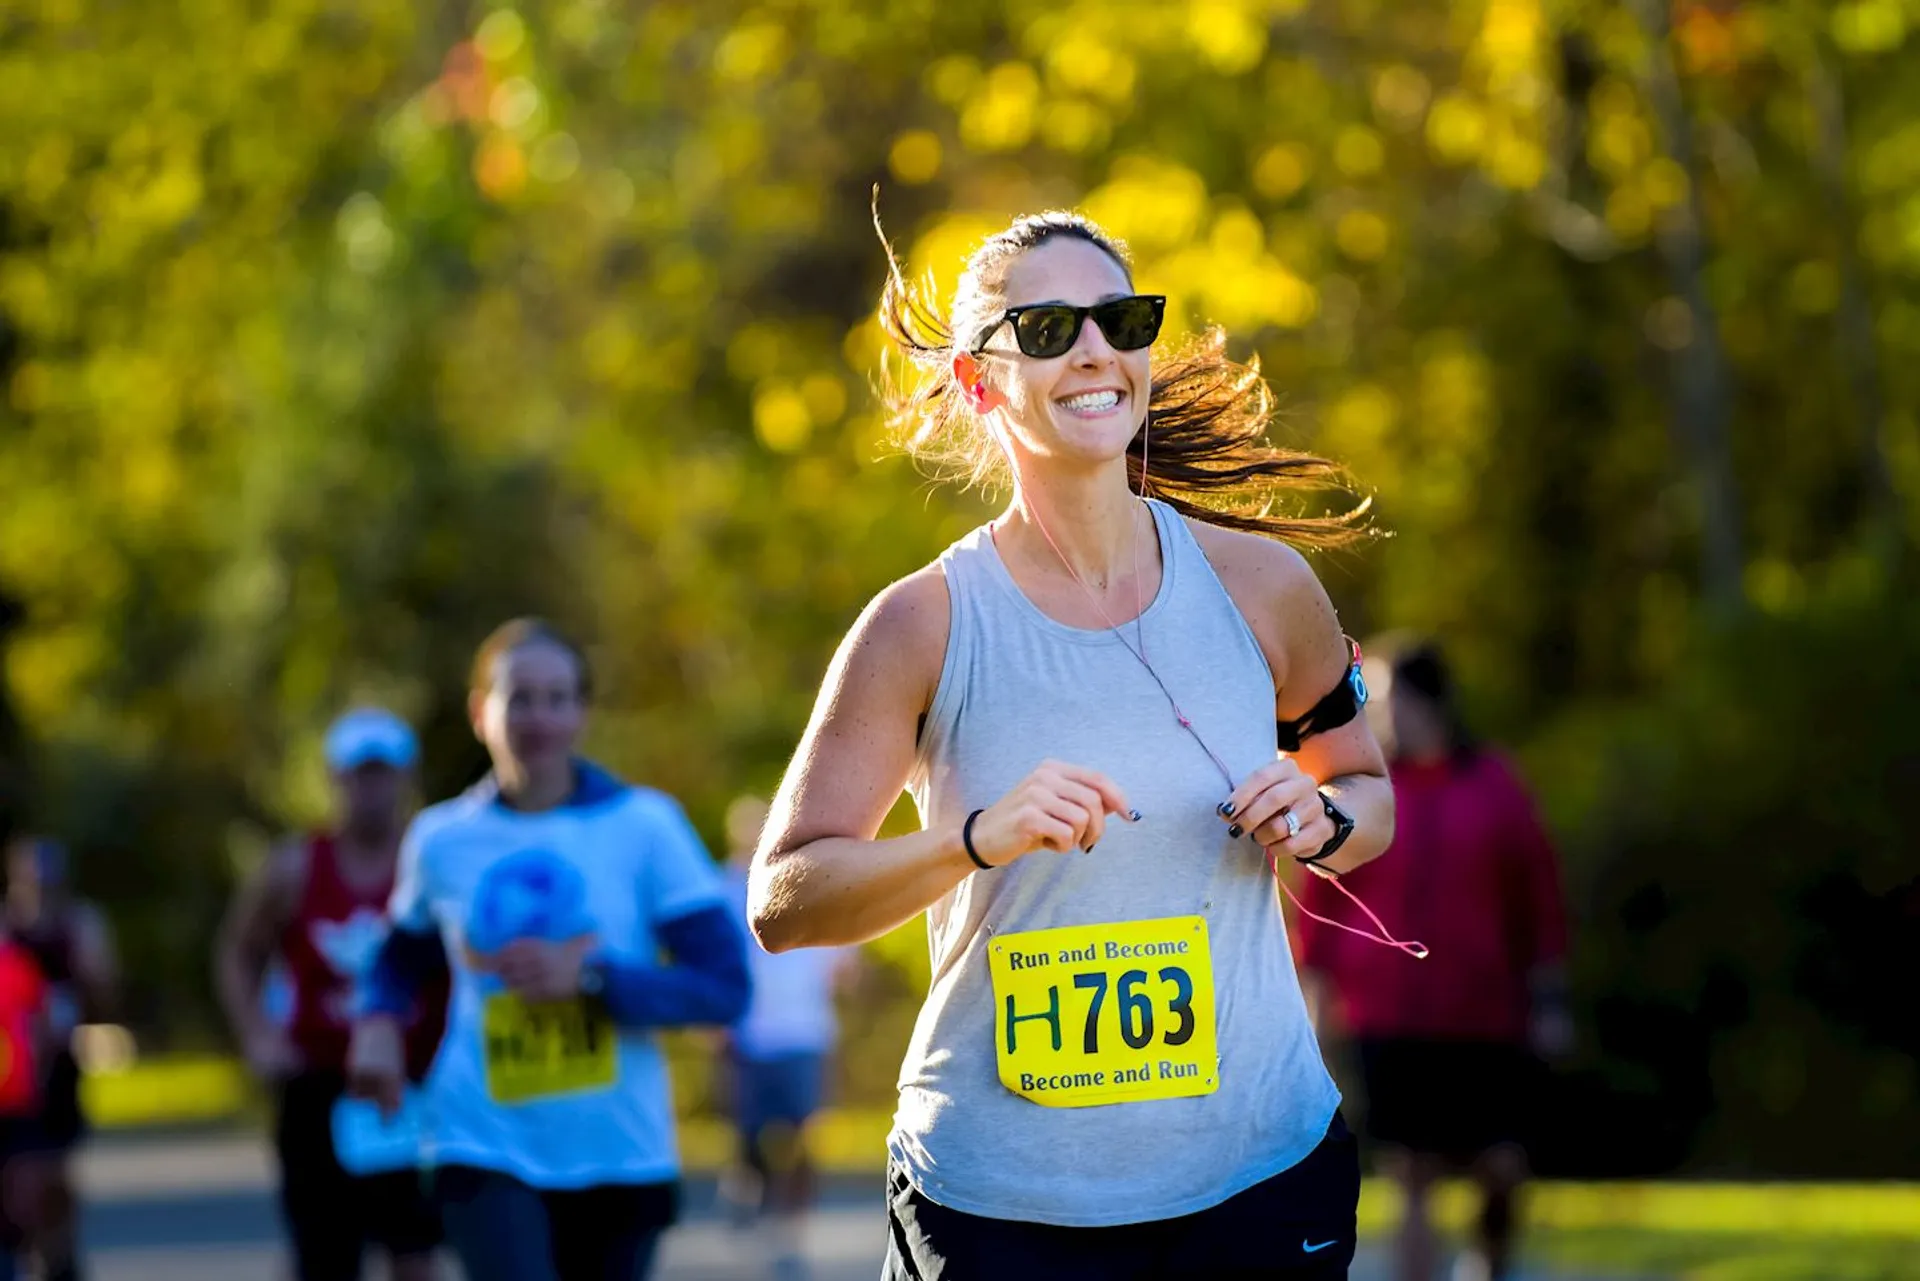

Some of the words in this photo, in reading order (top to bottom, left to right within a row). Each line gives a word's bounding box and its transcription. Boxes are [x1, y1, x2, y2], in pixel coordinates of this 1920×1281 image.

[1009, 952, 1050, 971] Run
[1058, 943, 1097, 964] and
[1104, 940, 1189, 959] Become
[1006, 966, 1195, 1055] H763
[1020, 1069, 1105, 1091] Become
[1113, 1062, 1151, 1083] and
[1158, 1060, 1198, 1079] Run
